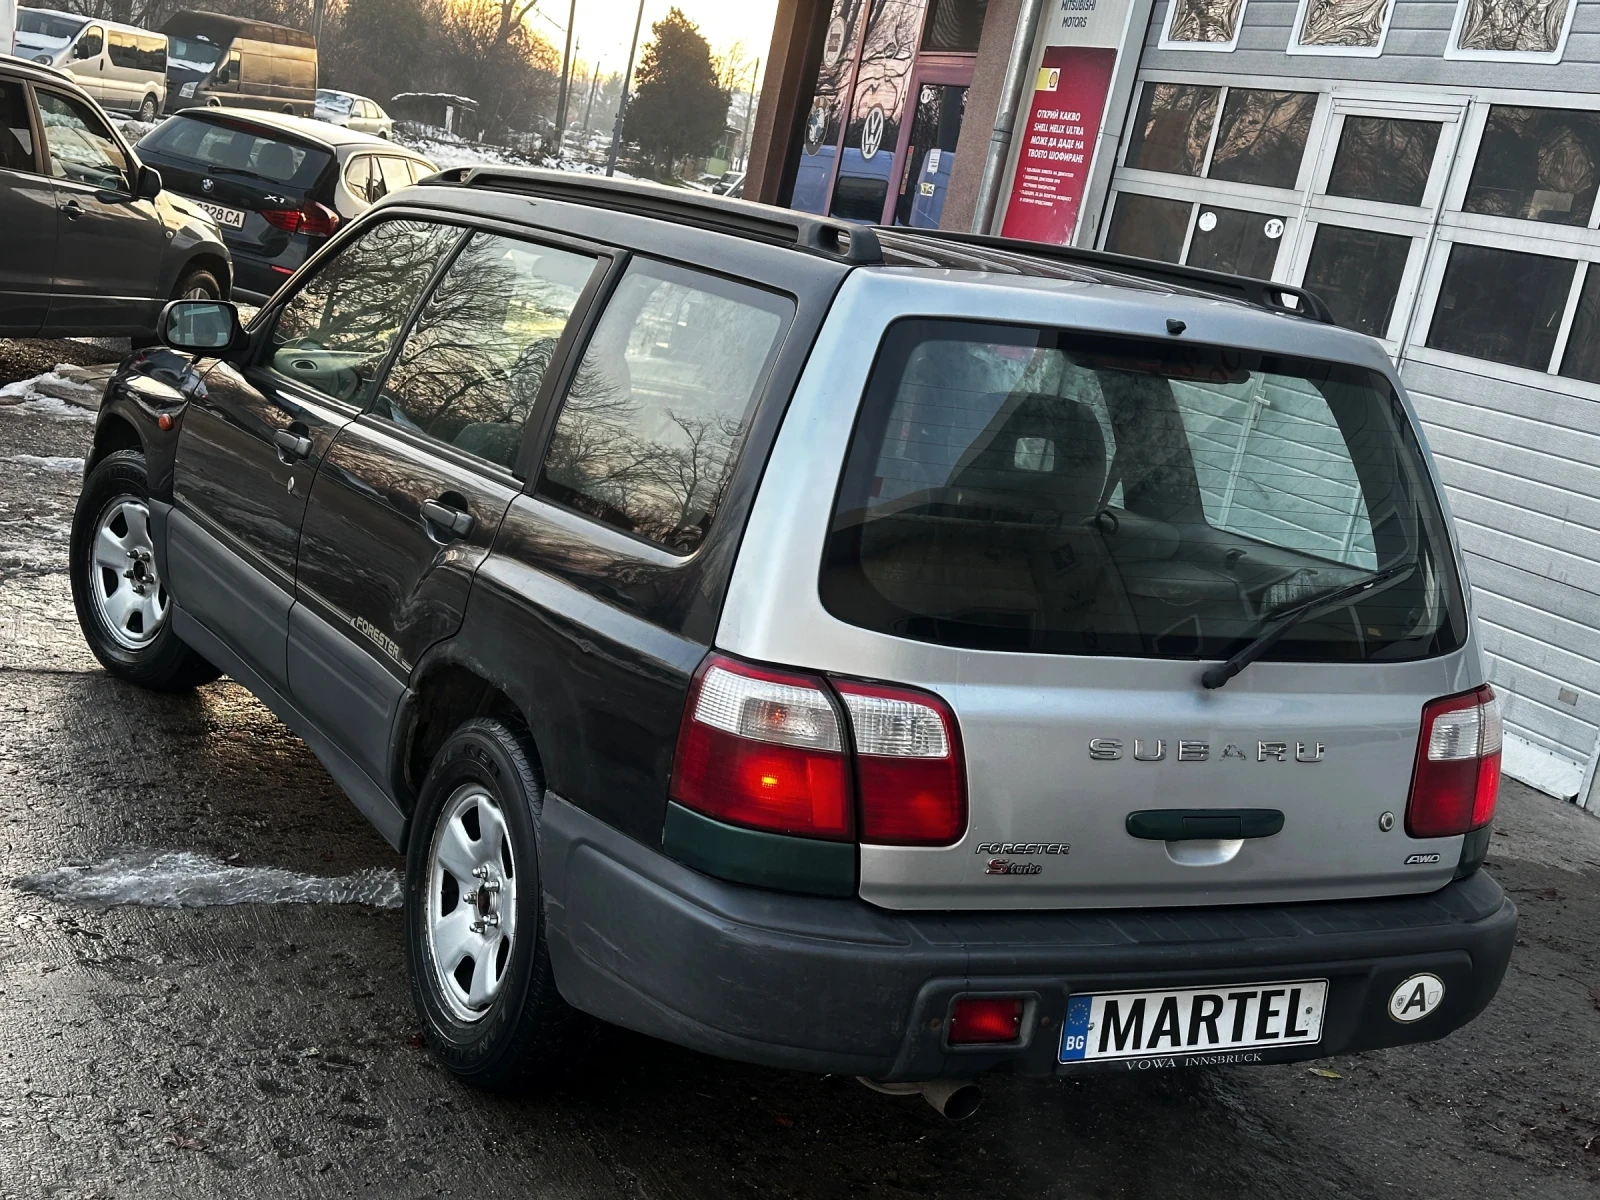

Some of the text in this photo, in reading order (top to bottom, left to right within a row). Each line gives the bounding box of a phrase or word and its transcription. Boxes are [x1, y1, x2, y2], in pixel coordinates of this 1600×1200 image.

[1061, 0, 1097, 11] MITSUBISHI
[1061, 16, 1088, 28] MOTORS
[1037, 109, 1081, 122] ОТКРИЙ КАКВО
[1033, 122, 1084, 136] SHELL HELIX ULTRA
[1030, 136, 1084, 150] МОЖЕ ДА ДАДЕ НА
[1028, 148, 1084, 163] ТВОЕТО ШОФИРАНЕ
[356, 616, 400, 660] FORESTER
[1088, 736, 1326, 763] SUBARU
[975, 842, 1071, 855] FORESTER
[1405, 853, 1441, 865] AWD
[1400, 981, 1427, 1015] A
[1065, 987, 1309, 1053] BG MARTEL
[1125, 1052, 1262, 1071] VOWA INNSBRUCK
